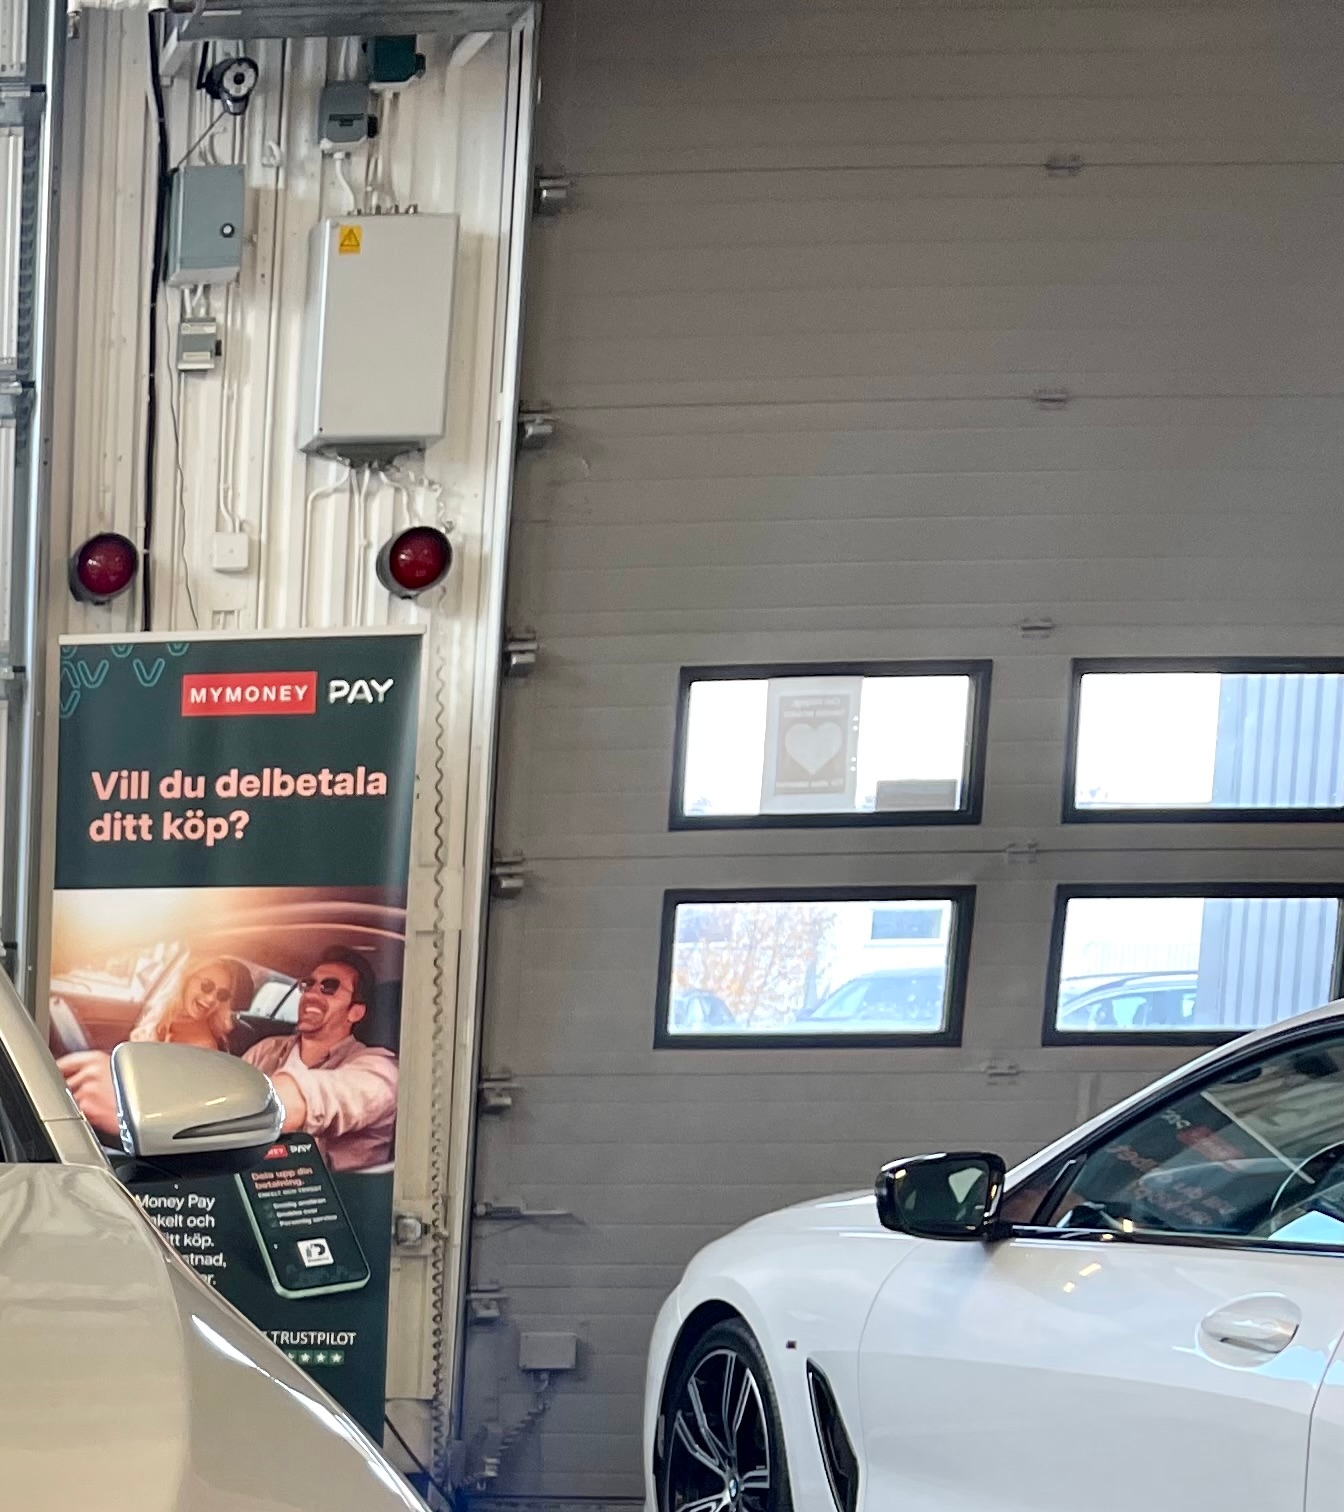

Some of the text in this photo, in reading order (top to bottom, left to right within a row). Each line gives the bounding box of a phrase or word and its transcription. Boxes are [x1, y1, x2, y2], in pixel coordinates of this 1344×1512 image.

[190, 678, 394, 704] MYMONEY PAY
[91, 767, 388, 800] Vill du delbetala
[89, 809, 250, 847] ditt köp?
[136, 1193, 216, 1211] Money Pay
[186, 1213, 216, 1228] och
[183, 1232, 215, 1250] köp.
[271, 1330, 357, 1346] TRUSTPILOT
